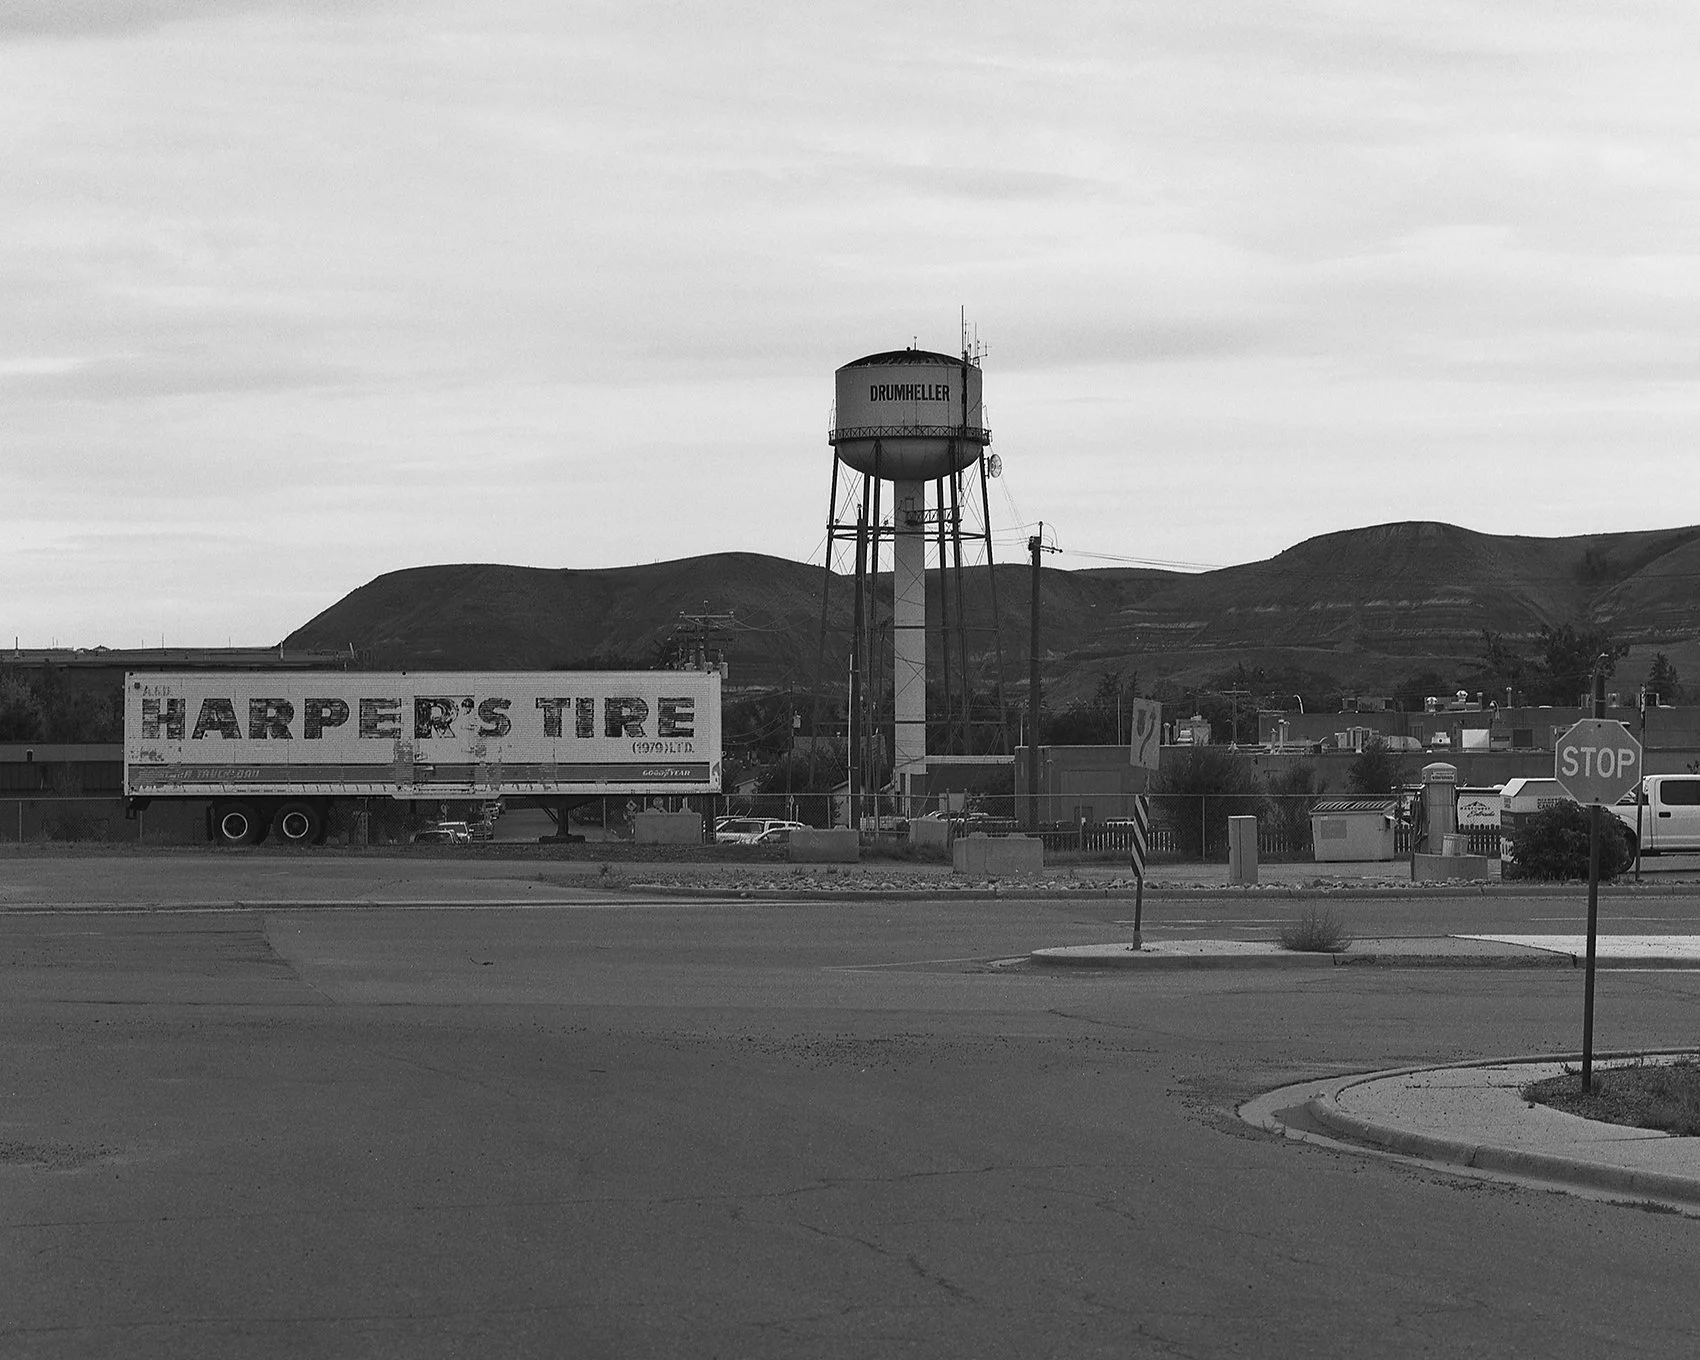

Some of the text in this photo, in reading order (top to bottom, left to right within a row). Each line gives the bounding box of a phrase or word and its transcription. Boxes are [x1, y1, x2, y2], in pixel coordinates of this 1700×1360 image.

[870, 384, 950, 401] DRUMHELLER
[142, 697, 695, 739] HARPER'S TIRE
[642, 769, 691, 777] GOODYEAR
[1561, 745, 1636, 778] STOP
